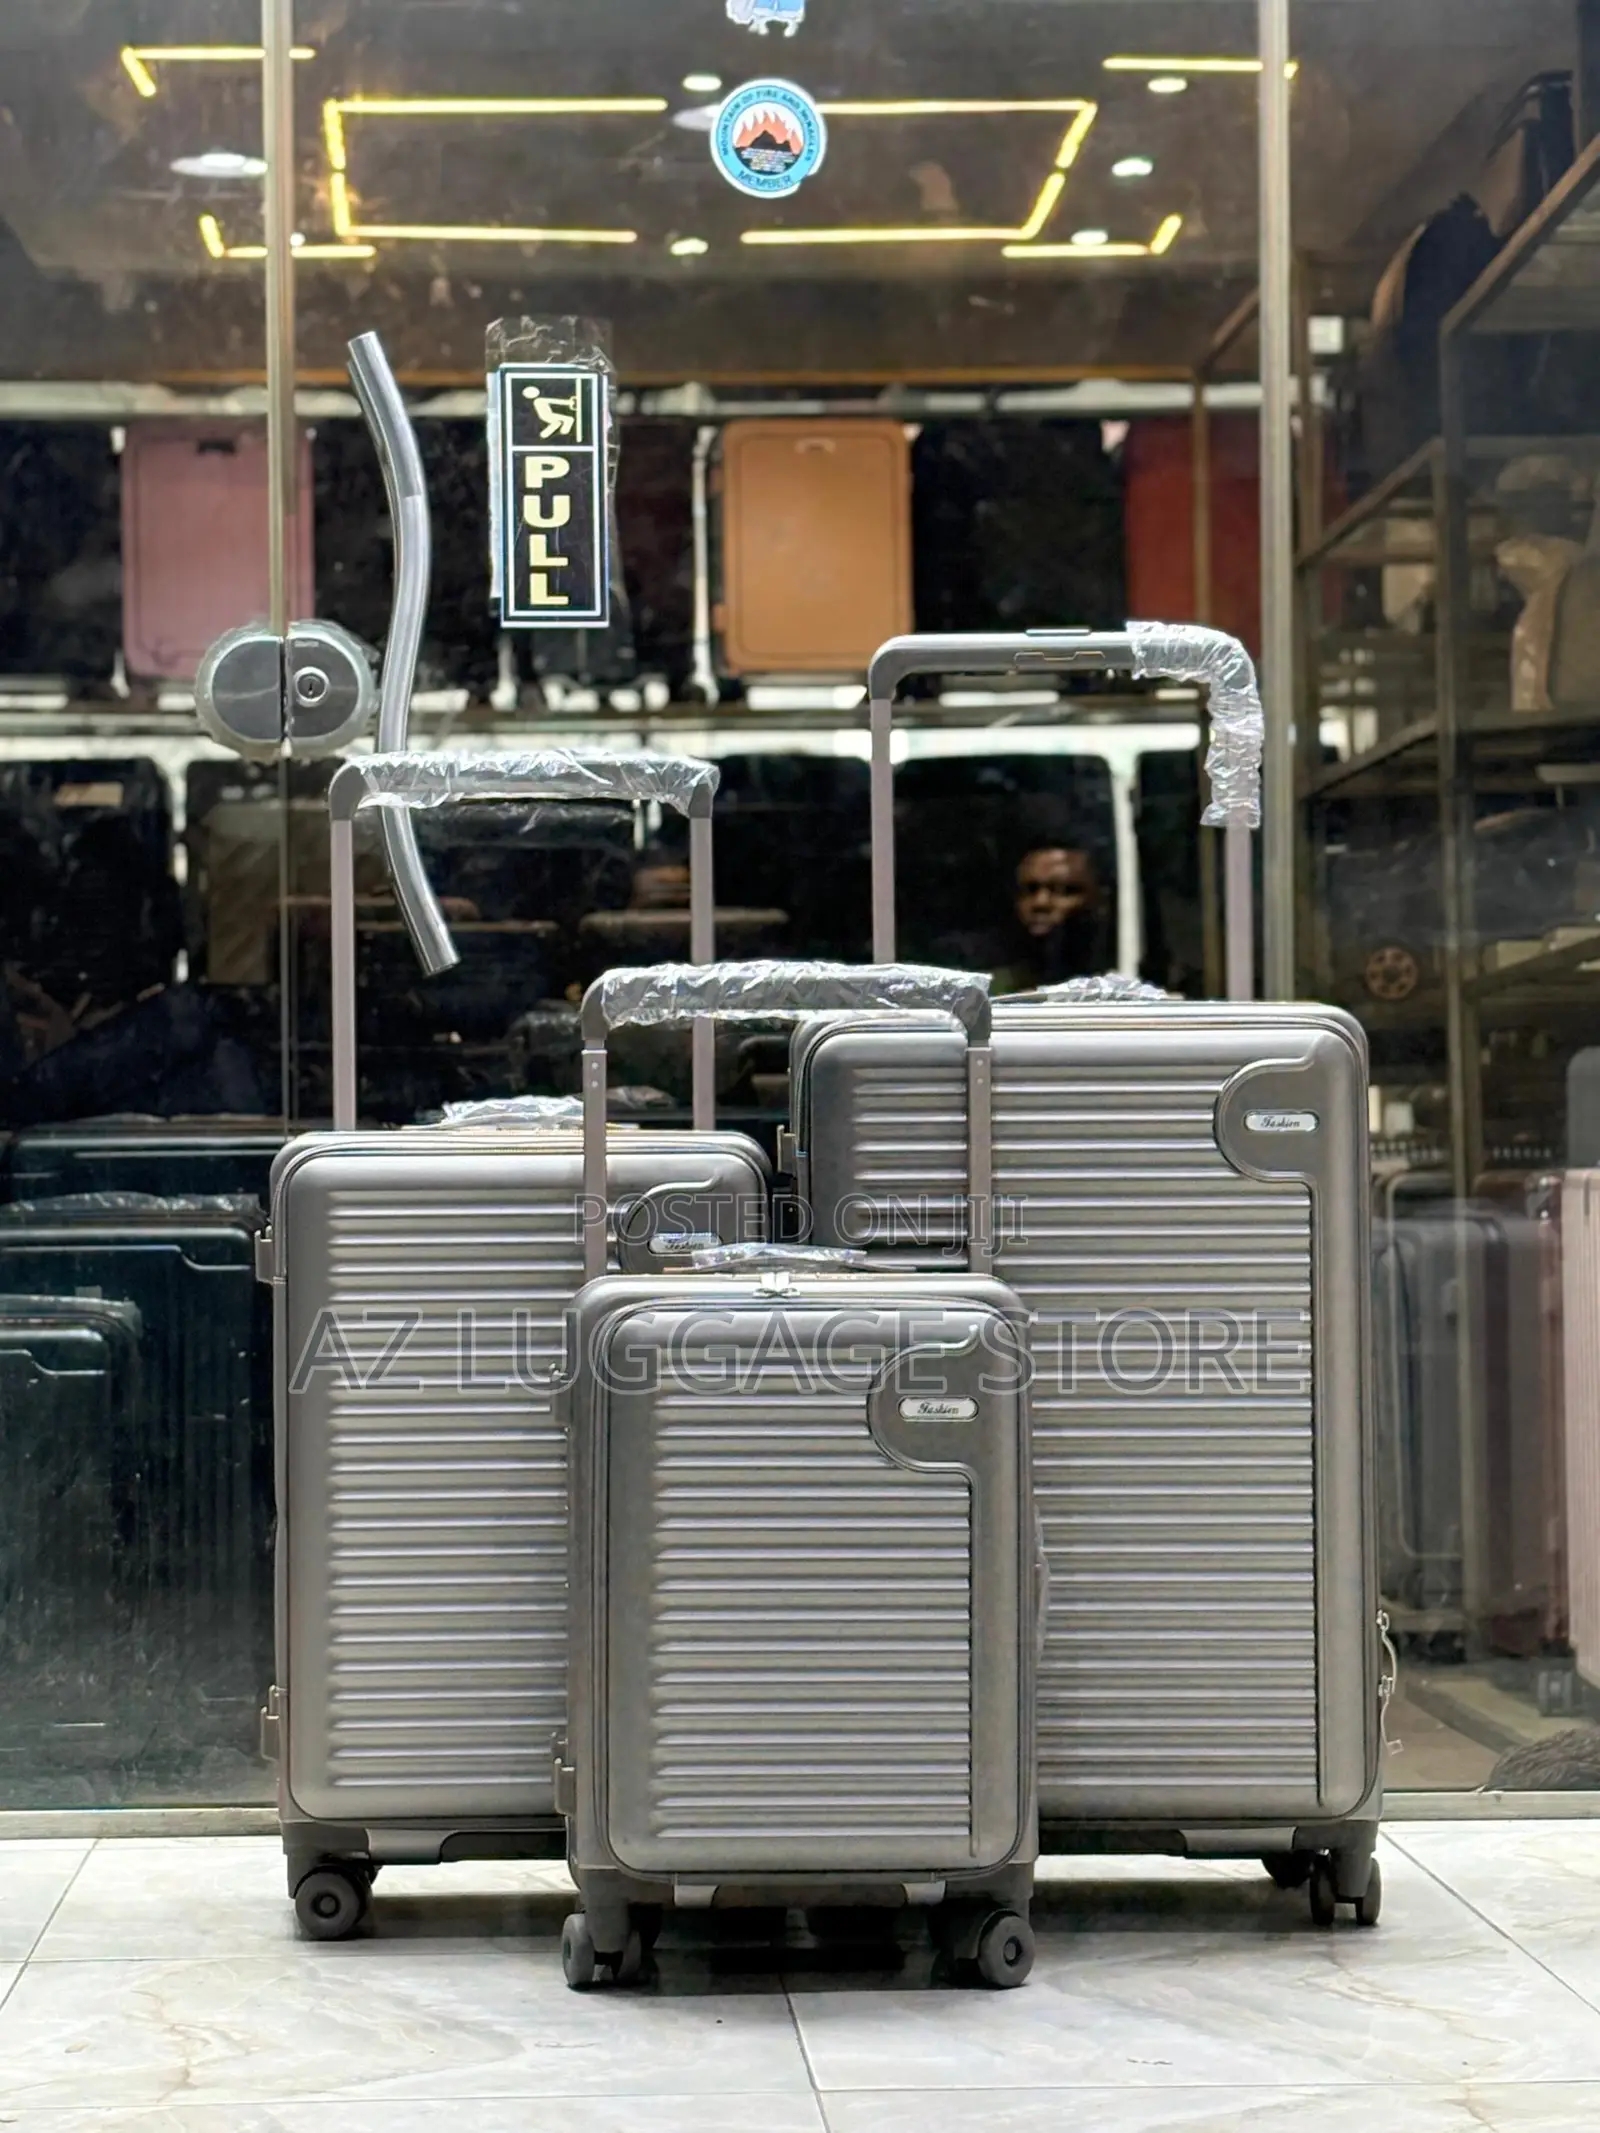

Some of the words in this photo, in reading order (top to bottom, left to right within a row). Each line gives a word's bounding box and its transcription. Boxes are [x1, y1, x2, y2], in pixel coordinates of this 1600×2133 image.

[755, 88, 778, 99] FIRE
[738, 170, 792, 189] MEMBER
[522, 455, 571, 606] PULL
